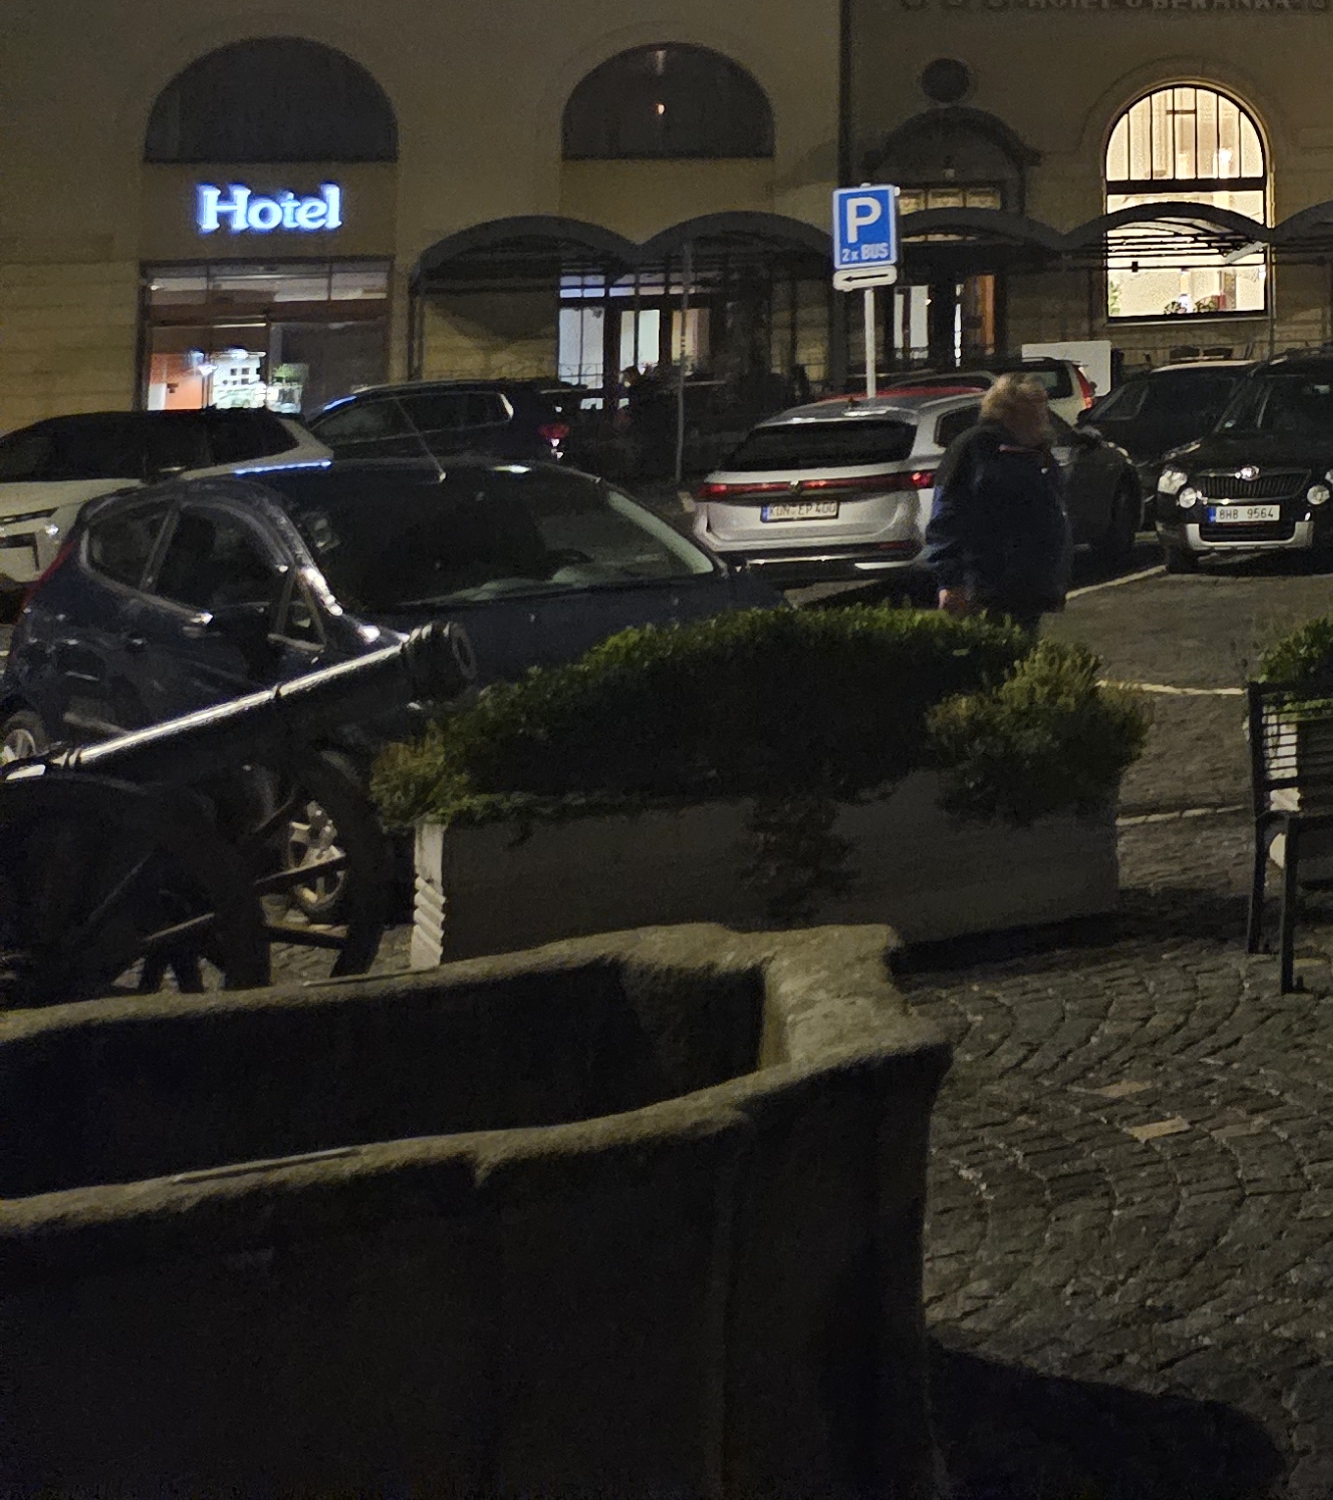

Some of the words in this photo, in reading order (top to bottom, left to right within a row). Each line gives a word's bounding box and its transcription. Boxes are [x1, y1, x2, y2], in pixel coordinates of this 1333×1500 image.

[198, 184, 342, 231] Hotel
[847, 196, 882, 243] P
[861, 243, 889, 260] BUS
[1247, 507, 1274, 519] 9564
